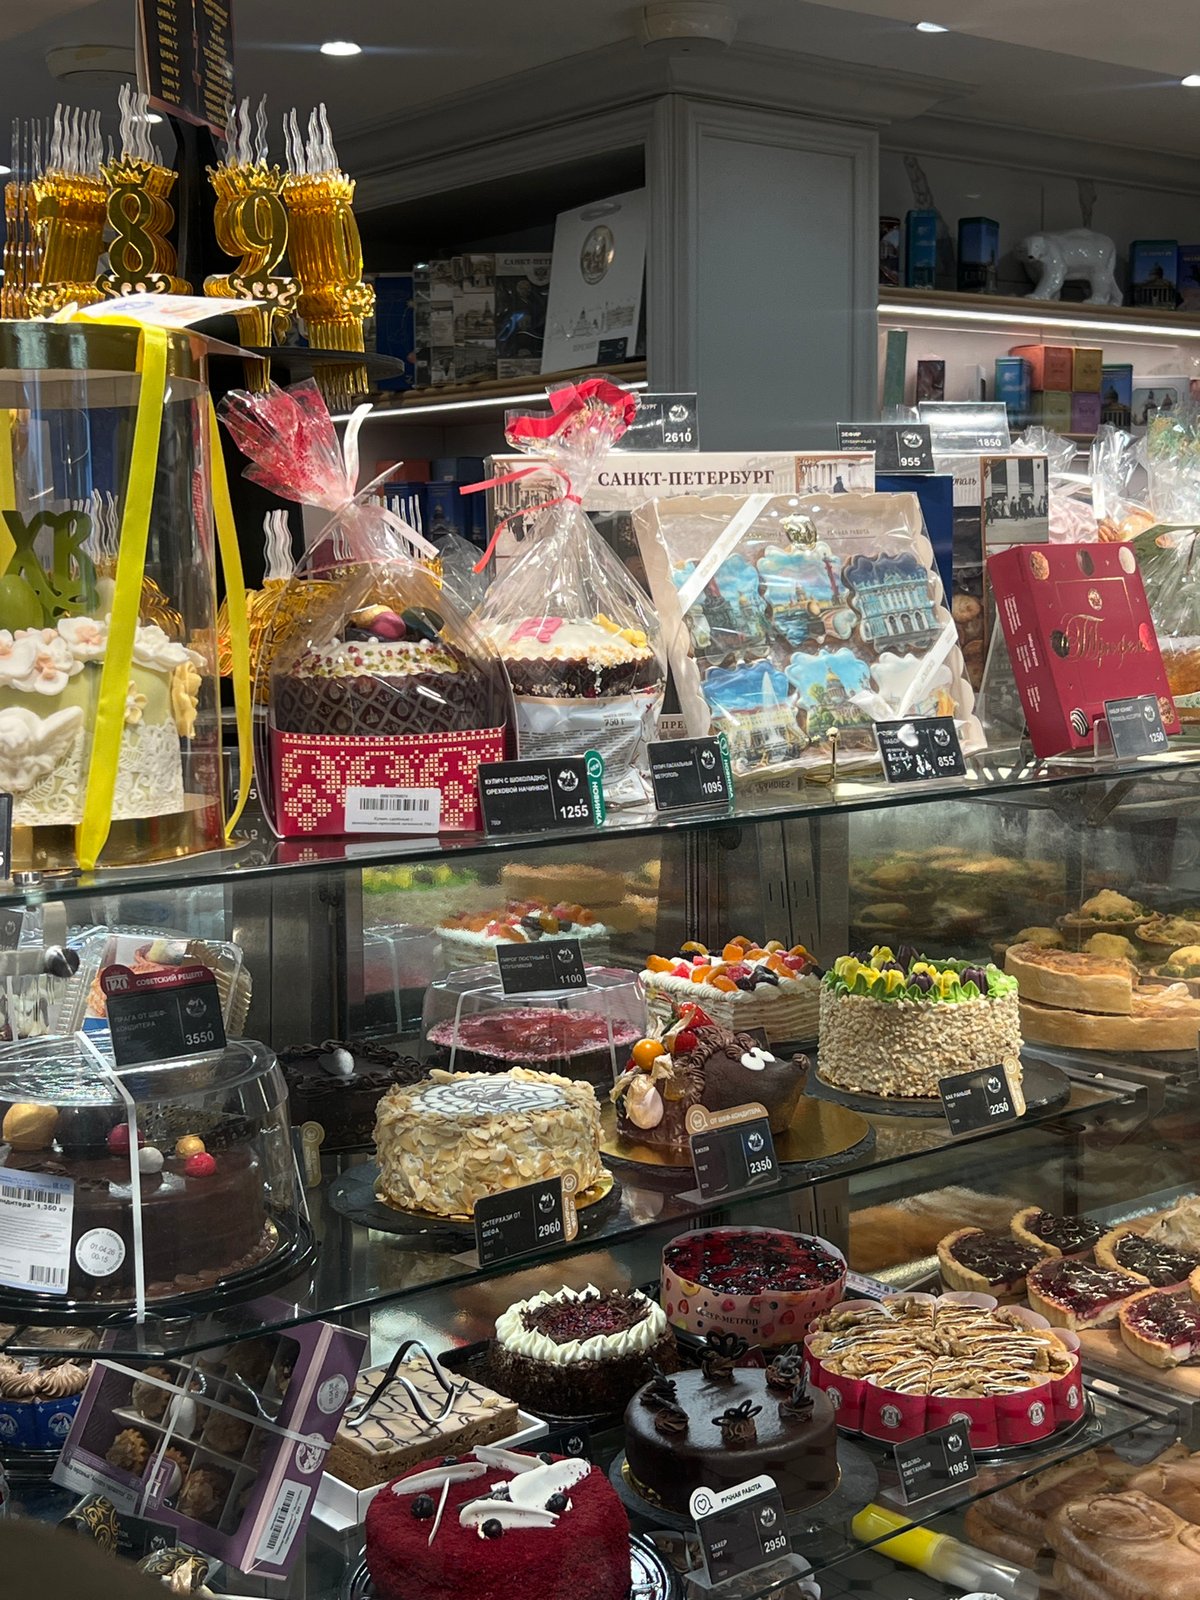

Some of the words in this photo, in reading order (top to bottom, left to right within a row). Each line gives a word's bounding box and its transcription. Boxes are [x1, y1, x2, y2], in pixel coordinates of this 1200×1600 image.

[665, 432, 692, 443] 2610
[978, 438, 1002, 447] 1850
[900, 457, 921, 467] 955
[598, 470, 775, 487] САНКТ-ПЕТЕРБУРГ
[1149, 731, 1165, 743] 1250
[937, 755, 956, 767] 855
[485, 784, 518, 796] ОРЕХОВОЙ
[702, 780, 723, 795] 1095
[591, 781, 603, 825] НОВИНКА
[559, 804, 590, 819] 1255
[136, 973, 177, 986] СОВЕТСКИЙ
[177, 970, 204, 981] РЕЦЕПТ
[559, 974, 583, 984] 1100
[114, 1013, 138, 1023] ПРАГА
[138, 1012, 148, 1020] ОТ
[115, 1020, 157, 1033] КОНДИТЕРА
[185, 1030, 215, 1046] 3550
[989, 1101, 1009, 1116] 2250
[749, 1159, 773, 1174] 2350
[481, 1213, 513, 1229] ЭСТЕРХАЗИ
[538, 1220, 561, 1238] 2960
[948, 1460, 970, 1477] 1985
[720, 1492, 742, 1505] РУЧНАЯ
[741, 1482, 763, 1497] РАБОТА
[710, 1539, 728, 1552] ЗАХЕР
[763, 1535, 787, 1554] 2950
